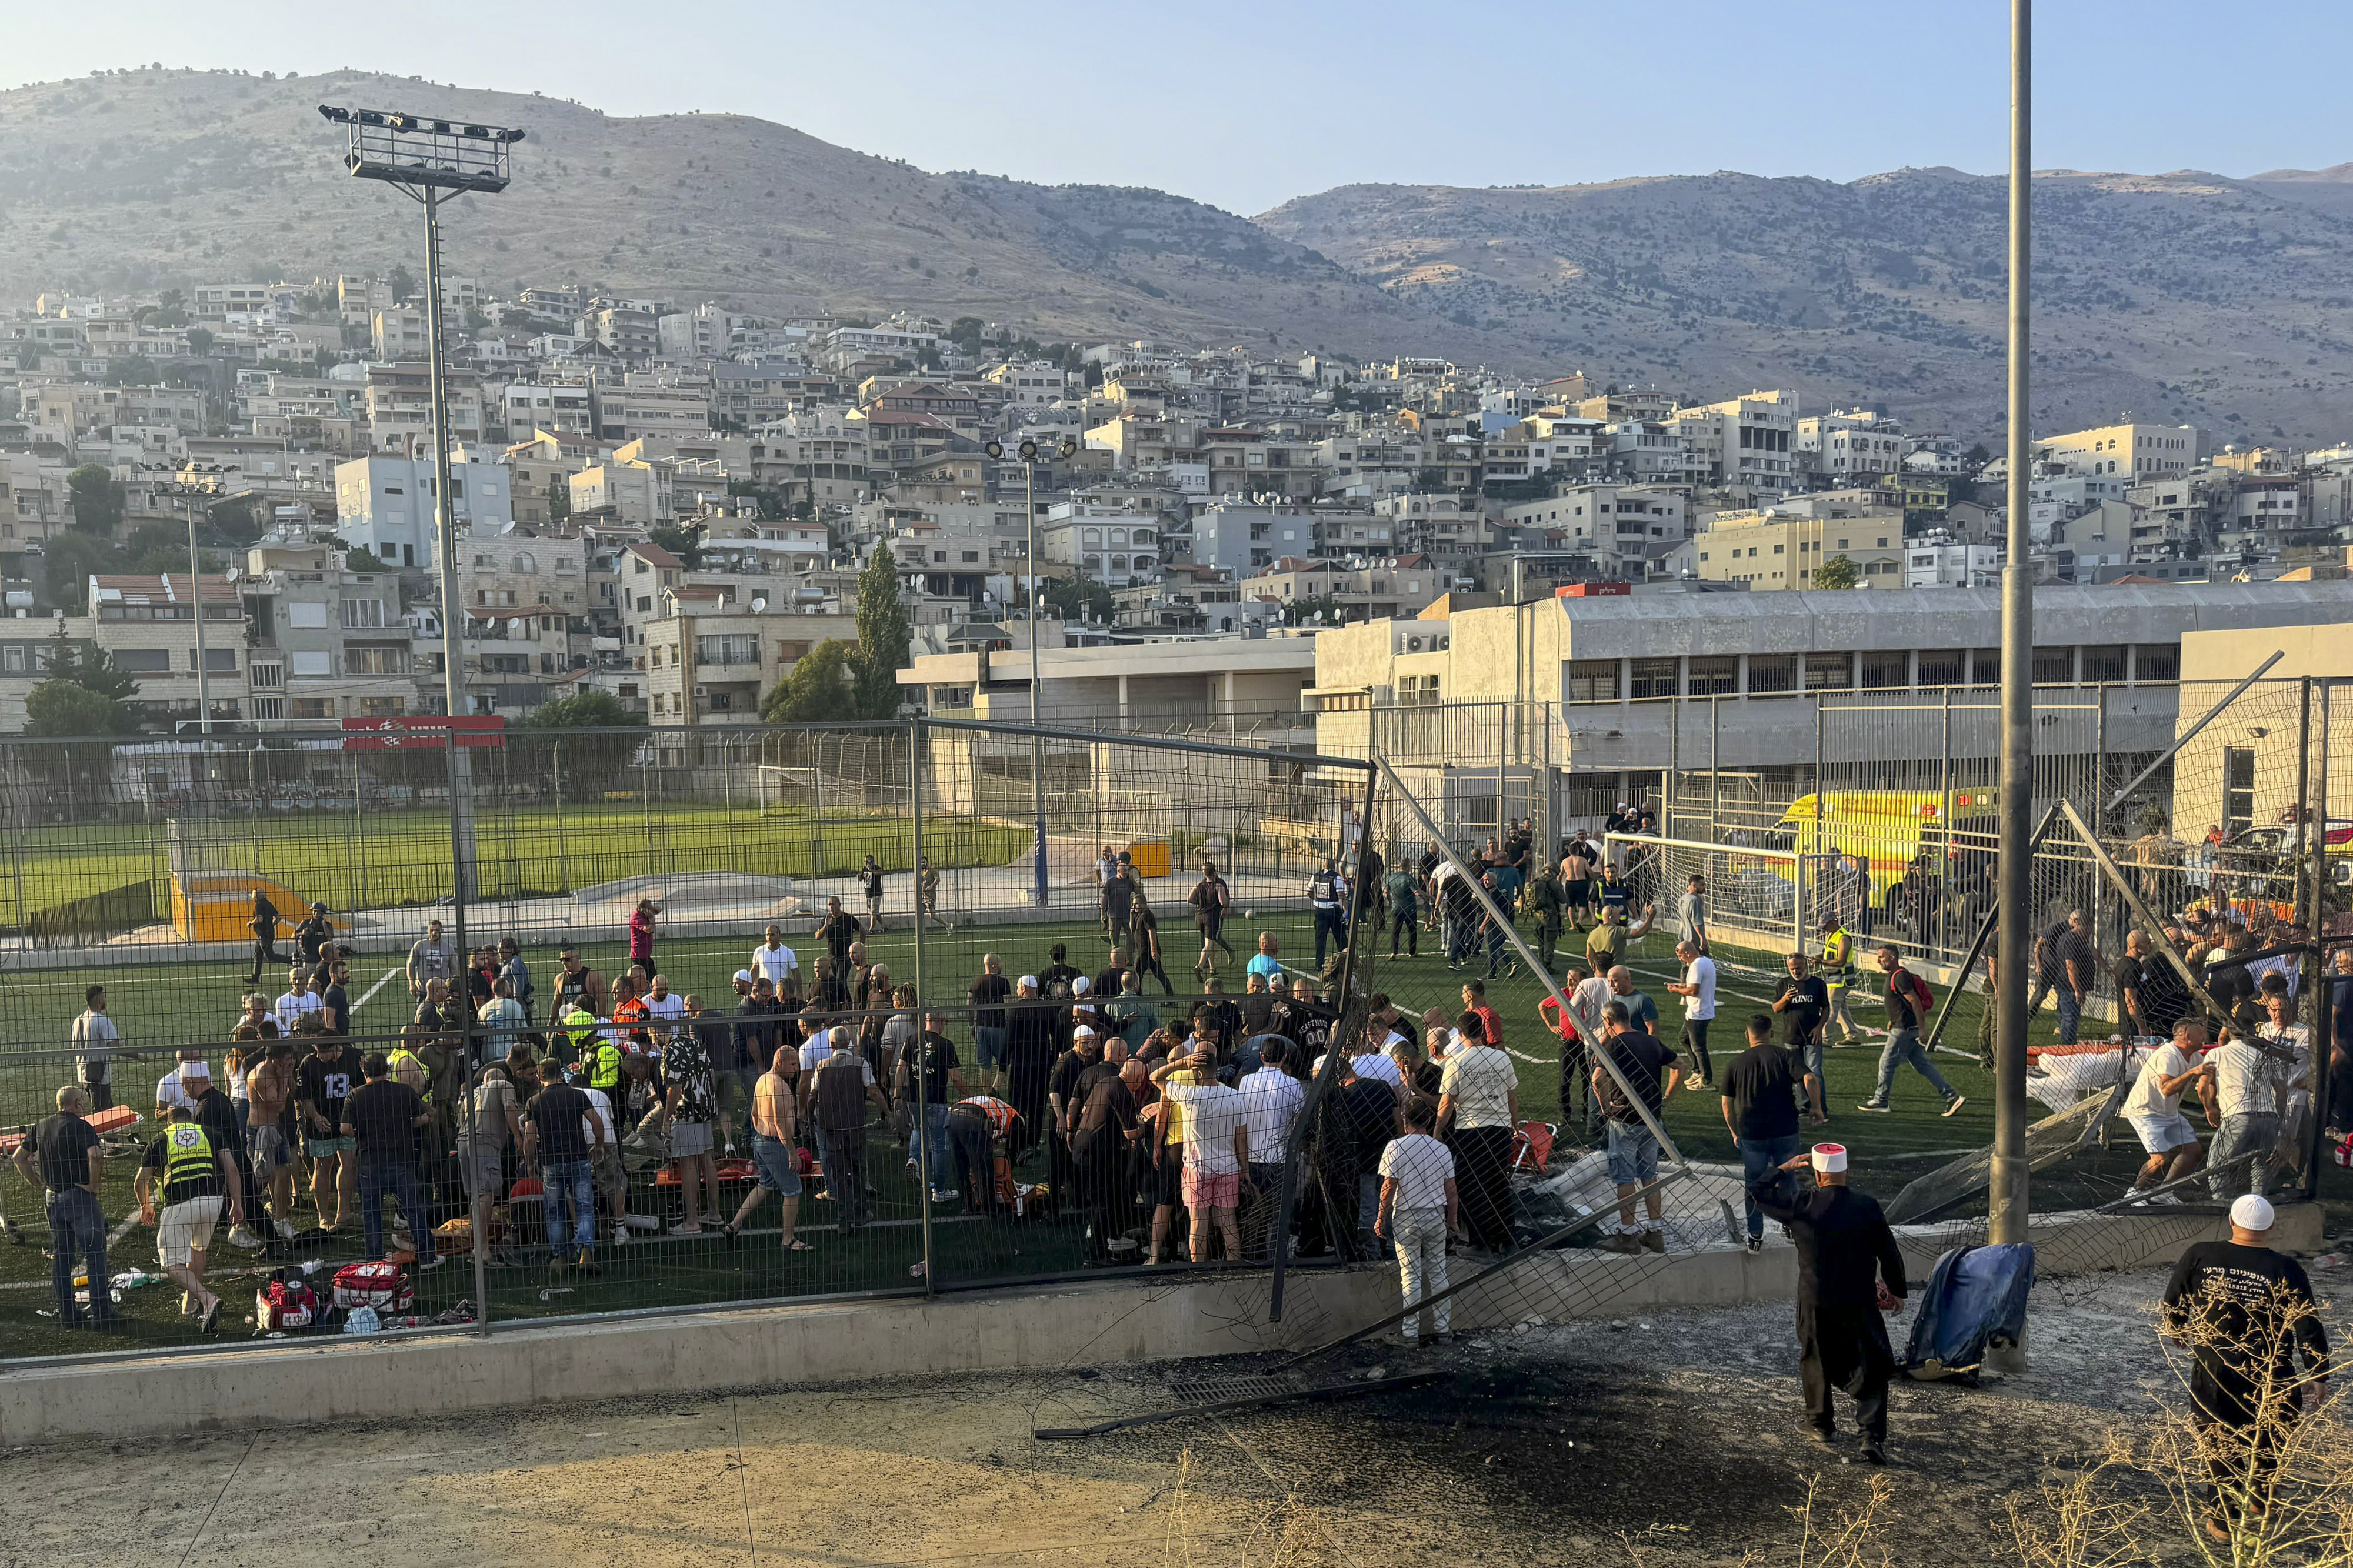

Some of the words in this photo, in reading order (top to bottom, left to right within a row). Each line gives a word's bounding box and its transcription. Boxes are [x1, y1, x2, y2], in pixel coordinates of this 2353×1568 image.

[1792, 995, 1814, 1003] KING
[1305, 1028, 1325, 1046] 00
[324, 1072, 350, 1099] 13
